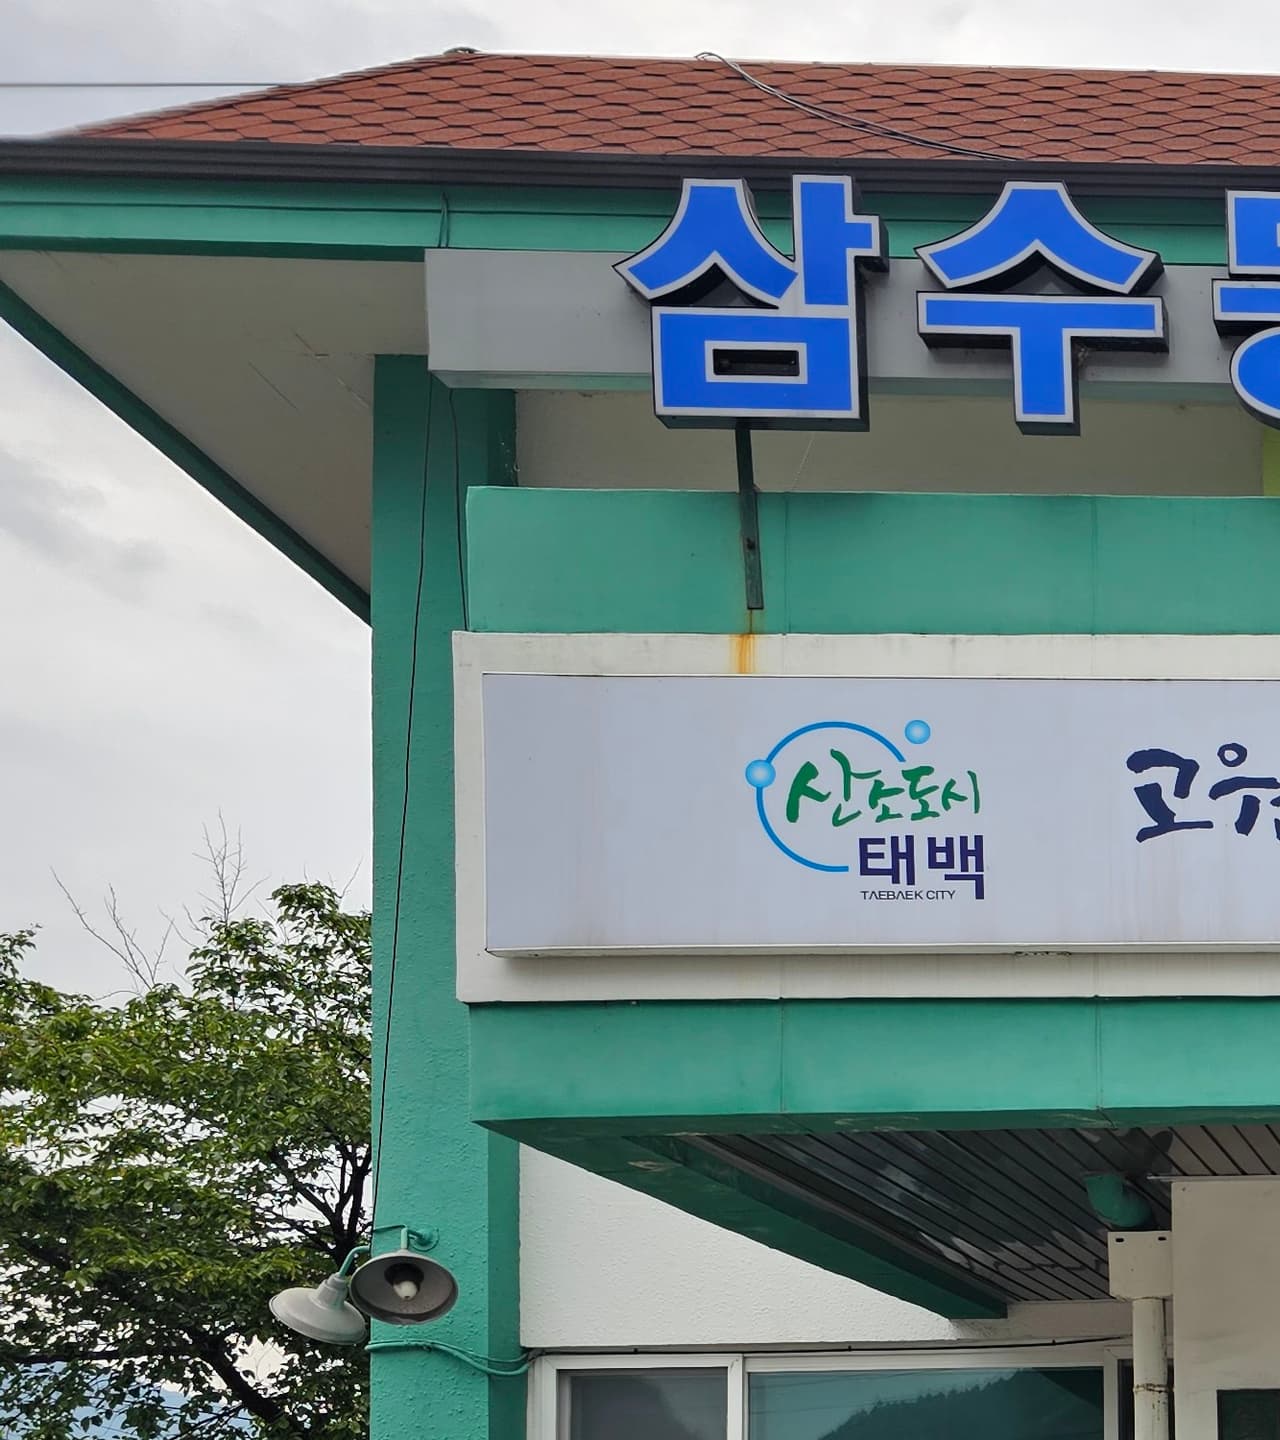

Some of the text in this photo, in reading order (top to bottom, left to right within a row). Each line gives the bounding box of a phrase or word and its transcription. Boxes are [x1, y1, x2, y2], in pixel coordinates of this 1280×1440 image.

[858, 835, 985, 900] 태백
[859, 889, 956, 900] TAEBAEK CITY
